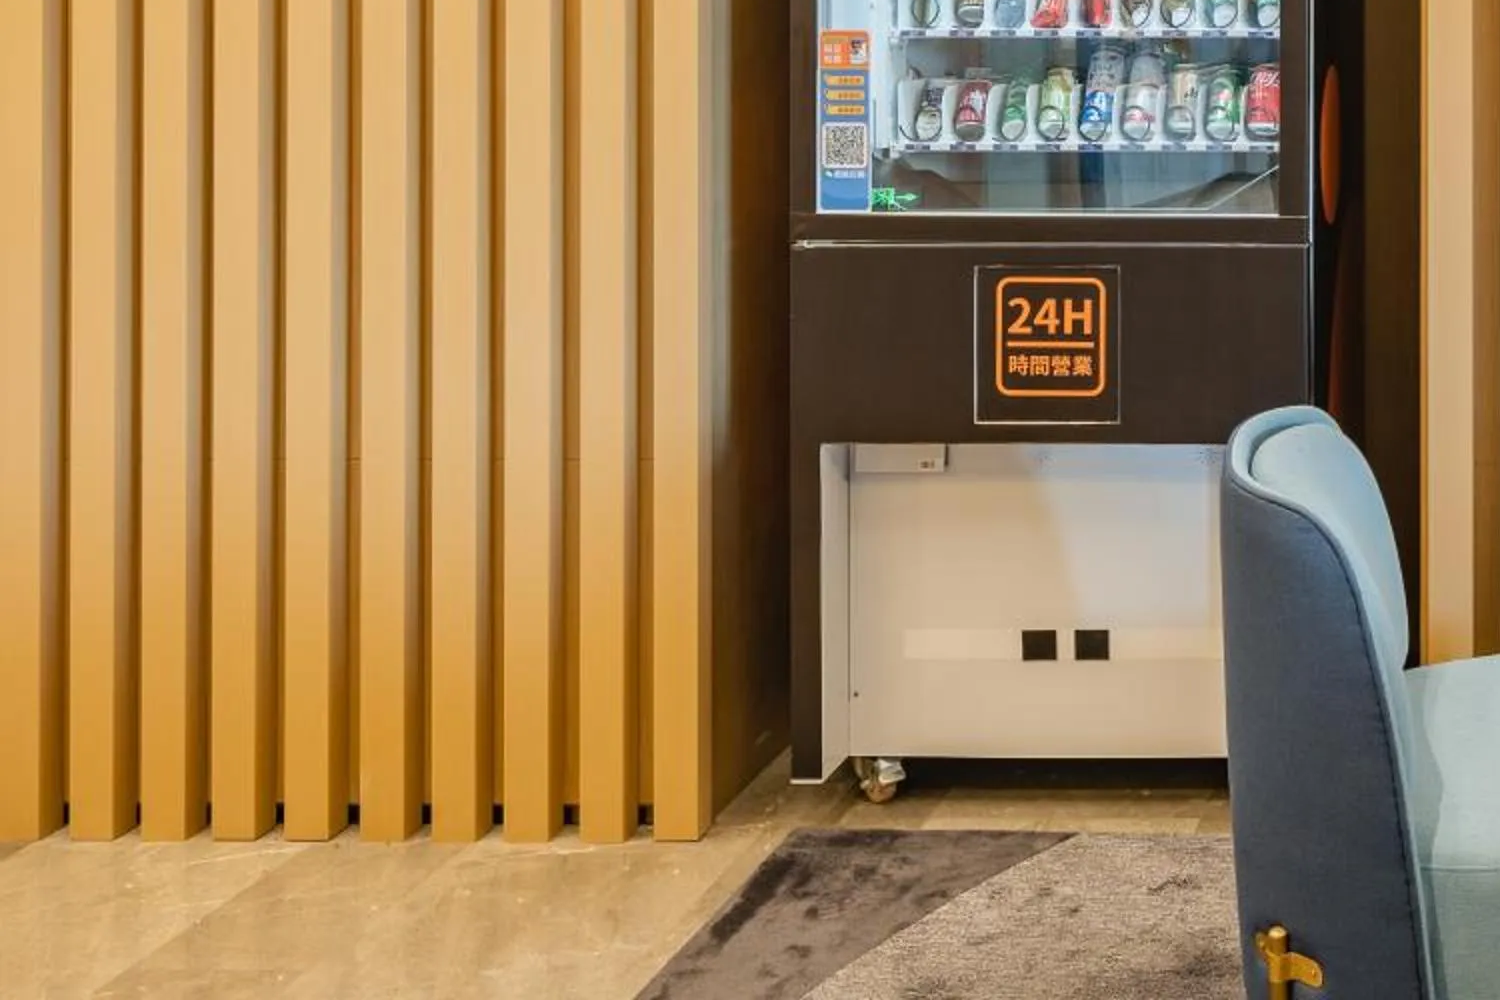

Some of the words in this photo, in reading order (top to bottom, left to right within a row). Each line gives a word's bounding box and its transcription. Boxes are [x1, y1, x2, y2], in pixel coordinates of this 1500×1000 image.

[1007, 297, 1093, 335] 24H
[1007, 354, 1093, 377] 時間營業
